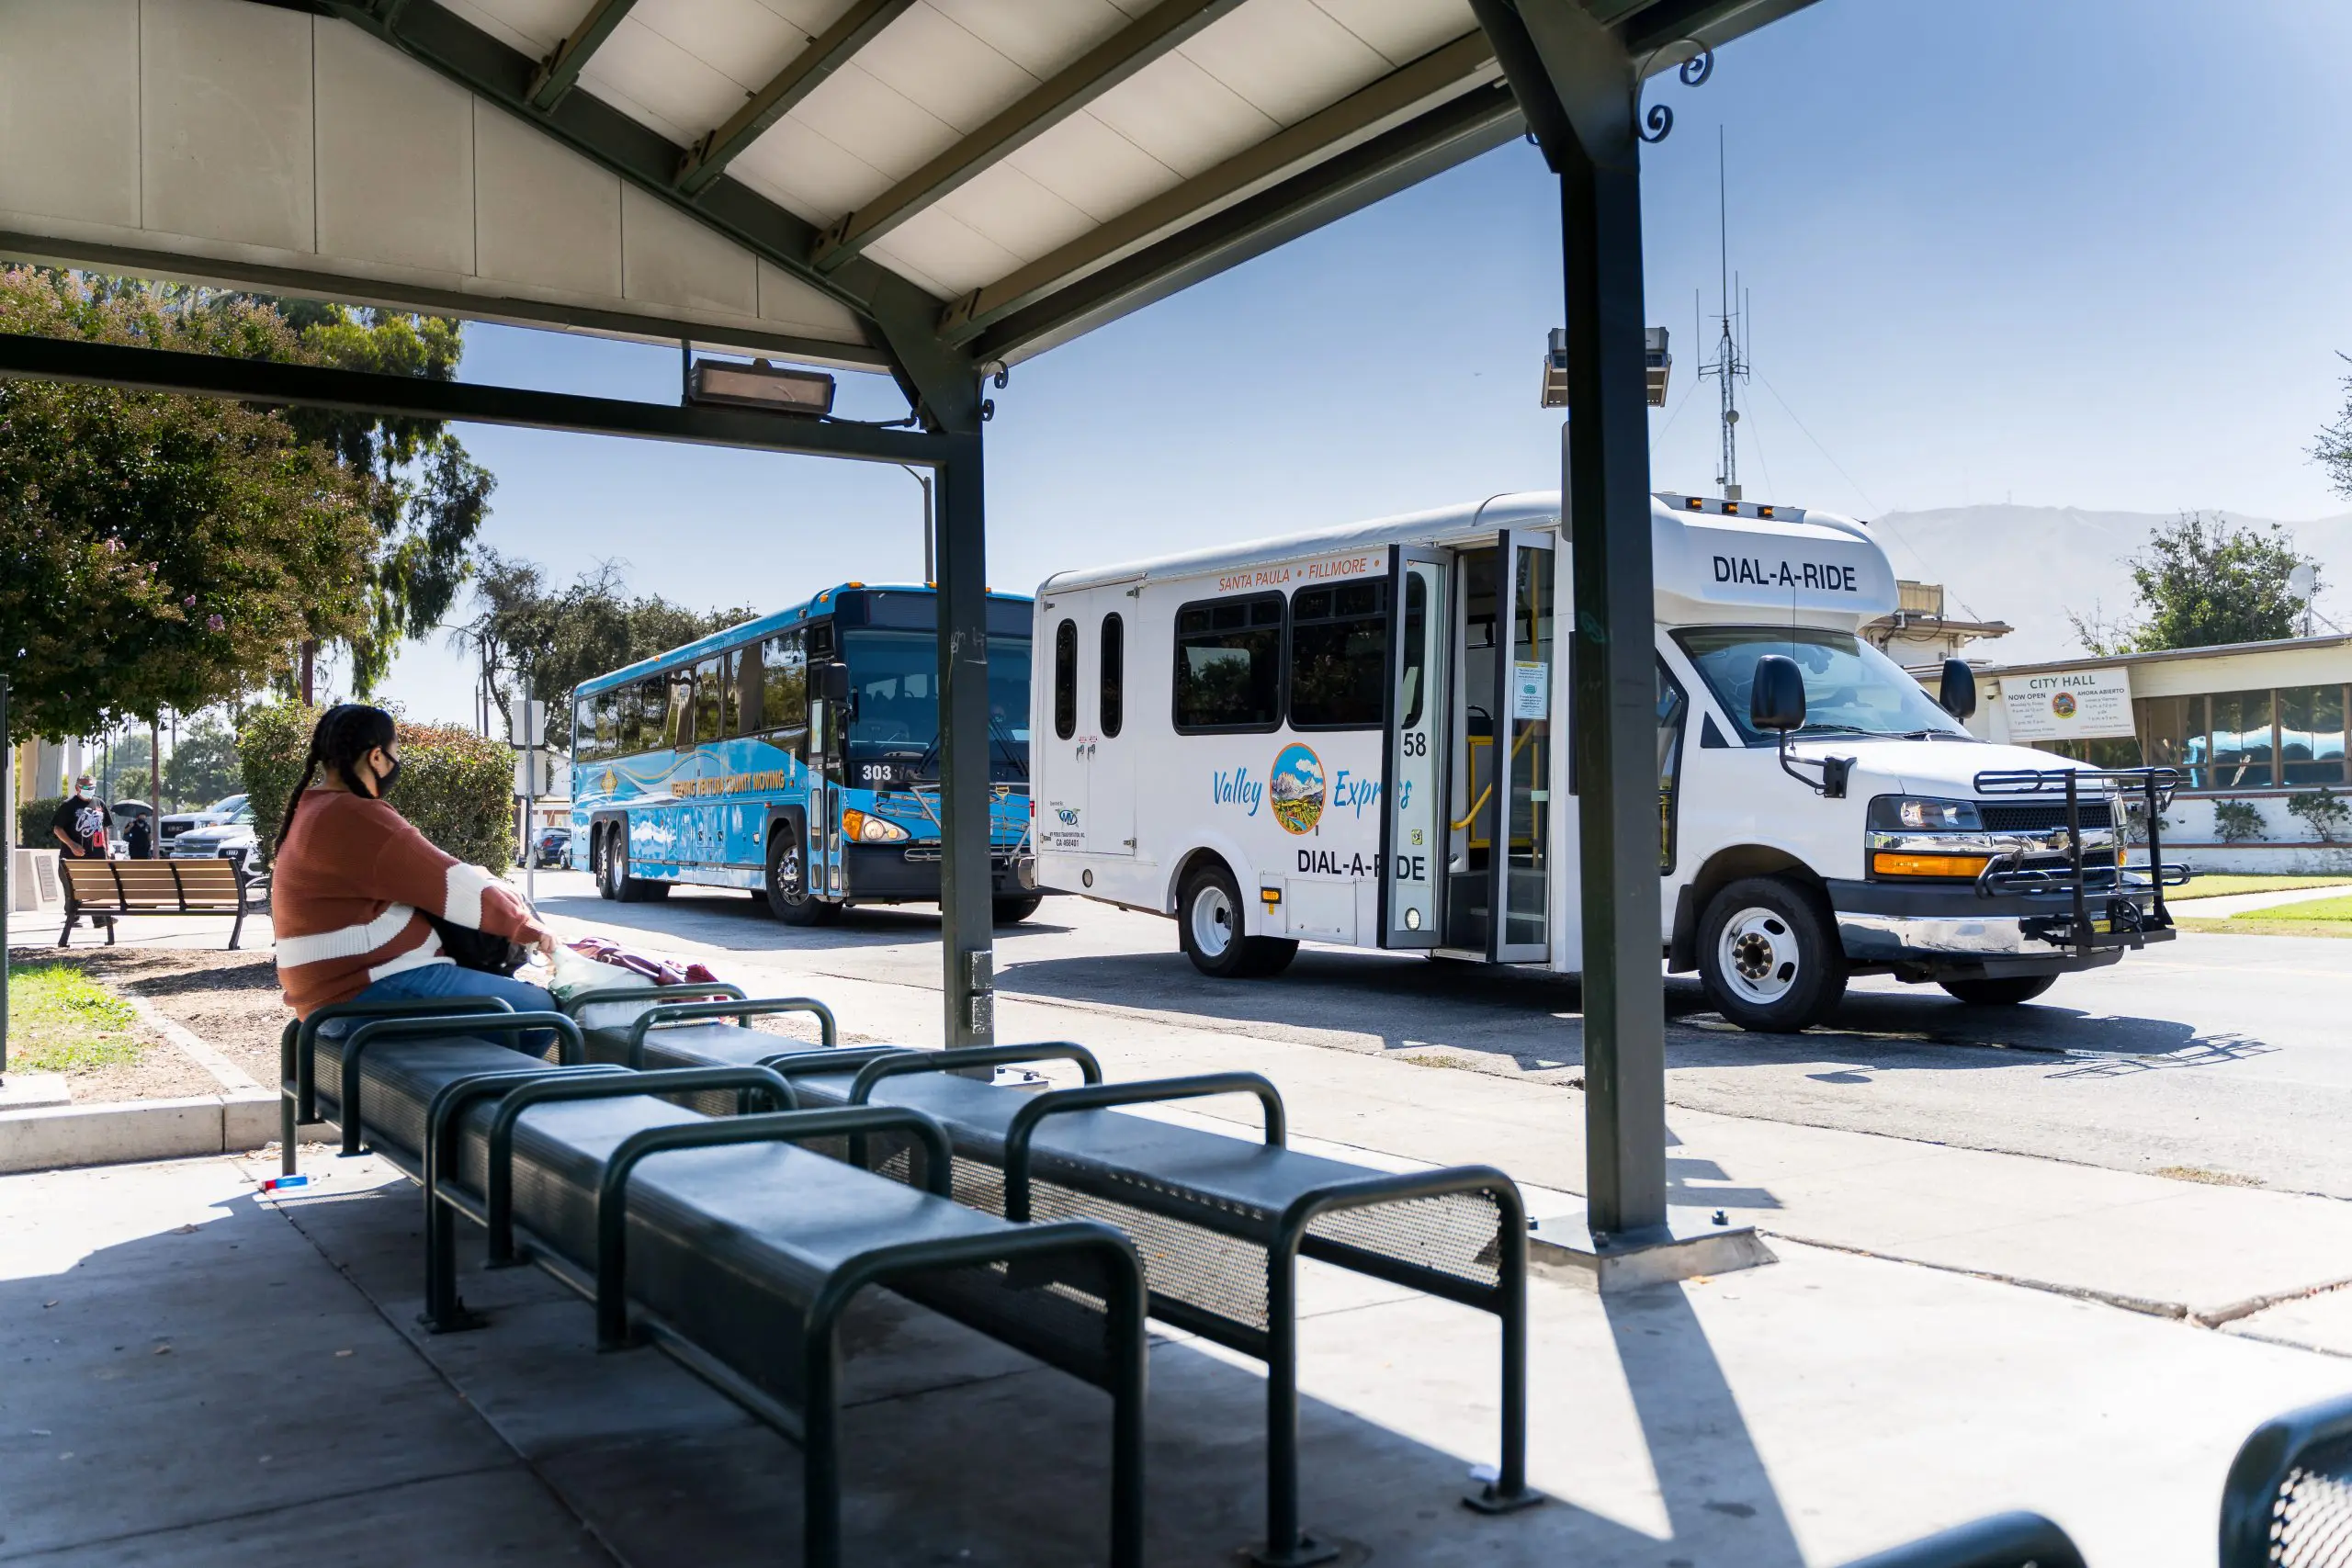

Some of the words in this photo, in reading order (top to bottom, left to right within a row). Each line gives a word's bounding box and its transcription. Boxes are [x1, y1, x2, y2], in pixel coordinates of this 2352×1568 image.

[1218, 573, 1252, 592] SANTA
[1255, 569, 1290, 586] PAULA
[1308, 558, 1367, 580] FILLMORE
[1713, 556, 1858, 592] DIAL-A-RIDE
[2030, 678, 2058, 689] CITY
[2063, 675, 2096, 686] HALL
[1404, 732, 1427, 757] 58
[671, 779, 696, 798] KEEPING
[697, 776, 725, 797] VENTURA
[726, 773, 752, 795] COUNTY
[752, 769, 786, 793] MOVING
[863, 765, 891, 780] 303
[1214, 767, 1262, 817] Valley
[1297, 849, 1426, 881] DIAL-A-DE
